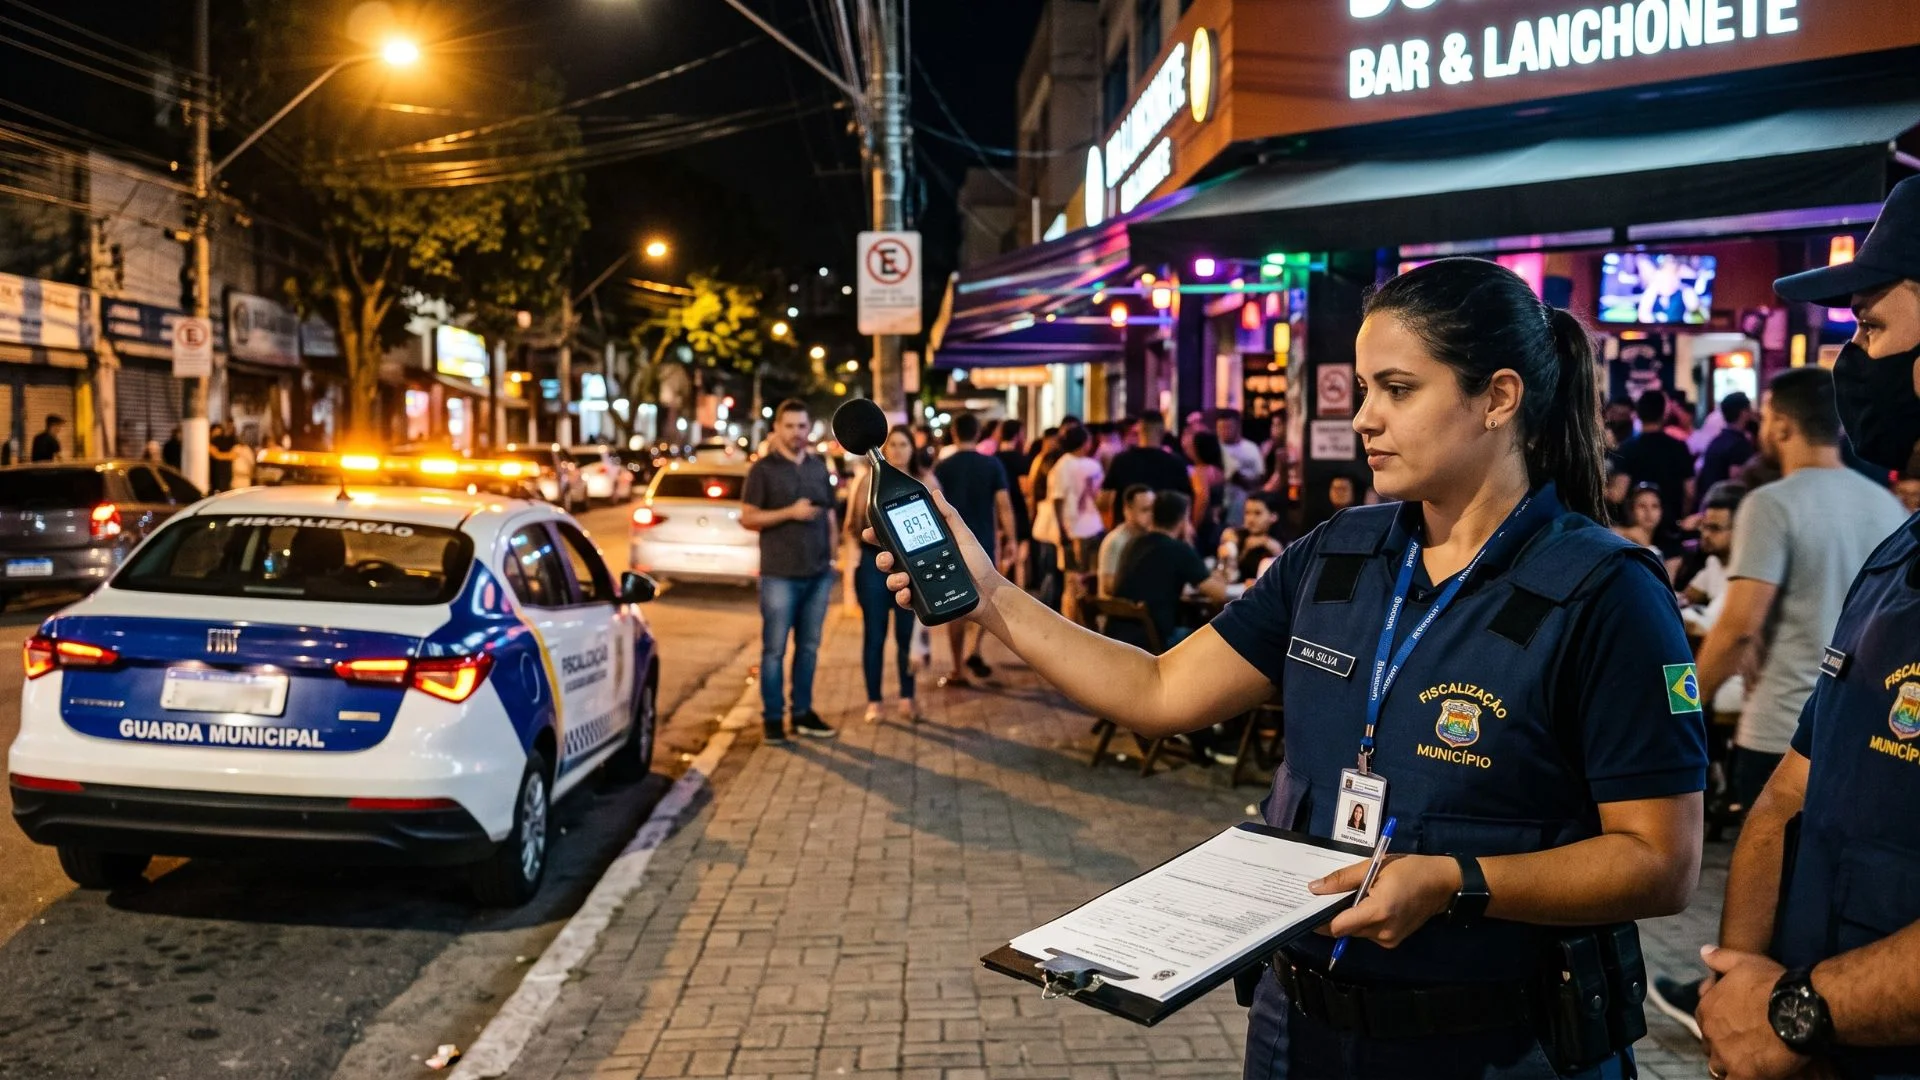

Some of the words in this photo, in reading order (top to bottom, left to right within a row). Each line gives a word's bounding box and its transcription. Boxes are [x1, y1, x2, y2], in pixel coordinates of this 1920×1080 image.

[1349, 39, 1430, 98] BAR
[1439, 32, 1473, 84] &
[1484, 0, 1799, 78] LANCHONETE
[881, 249, 897, 274] E
[903, 513, 932, 535] 89.7
[1300, 646, 1316, 660] ANA
[1315, 649, 1338, 667] SILVA
[1418, 682, 1507, 719] FISCALIZAÇÃO
[119, 718, 204, 742] GUARDA
[208, 725, 325, 748] MUNICIPAL
[1417, 743, 1492, 769] MUNICÍPIO
[1869, 735, 1920, 765] MUNICÍP
